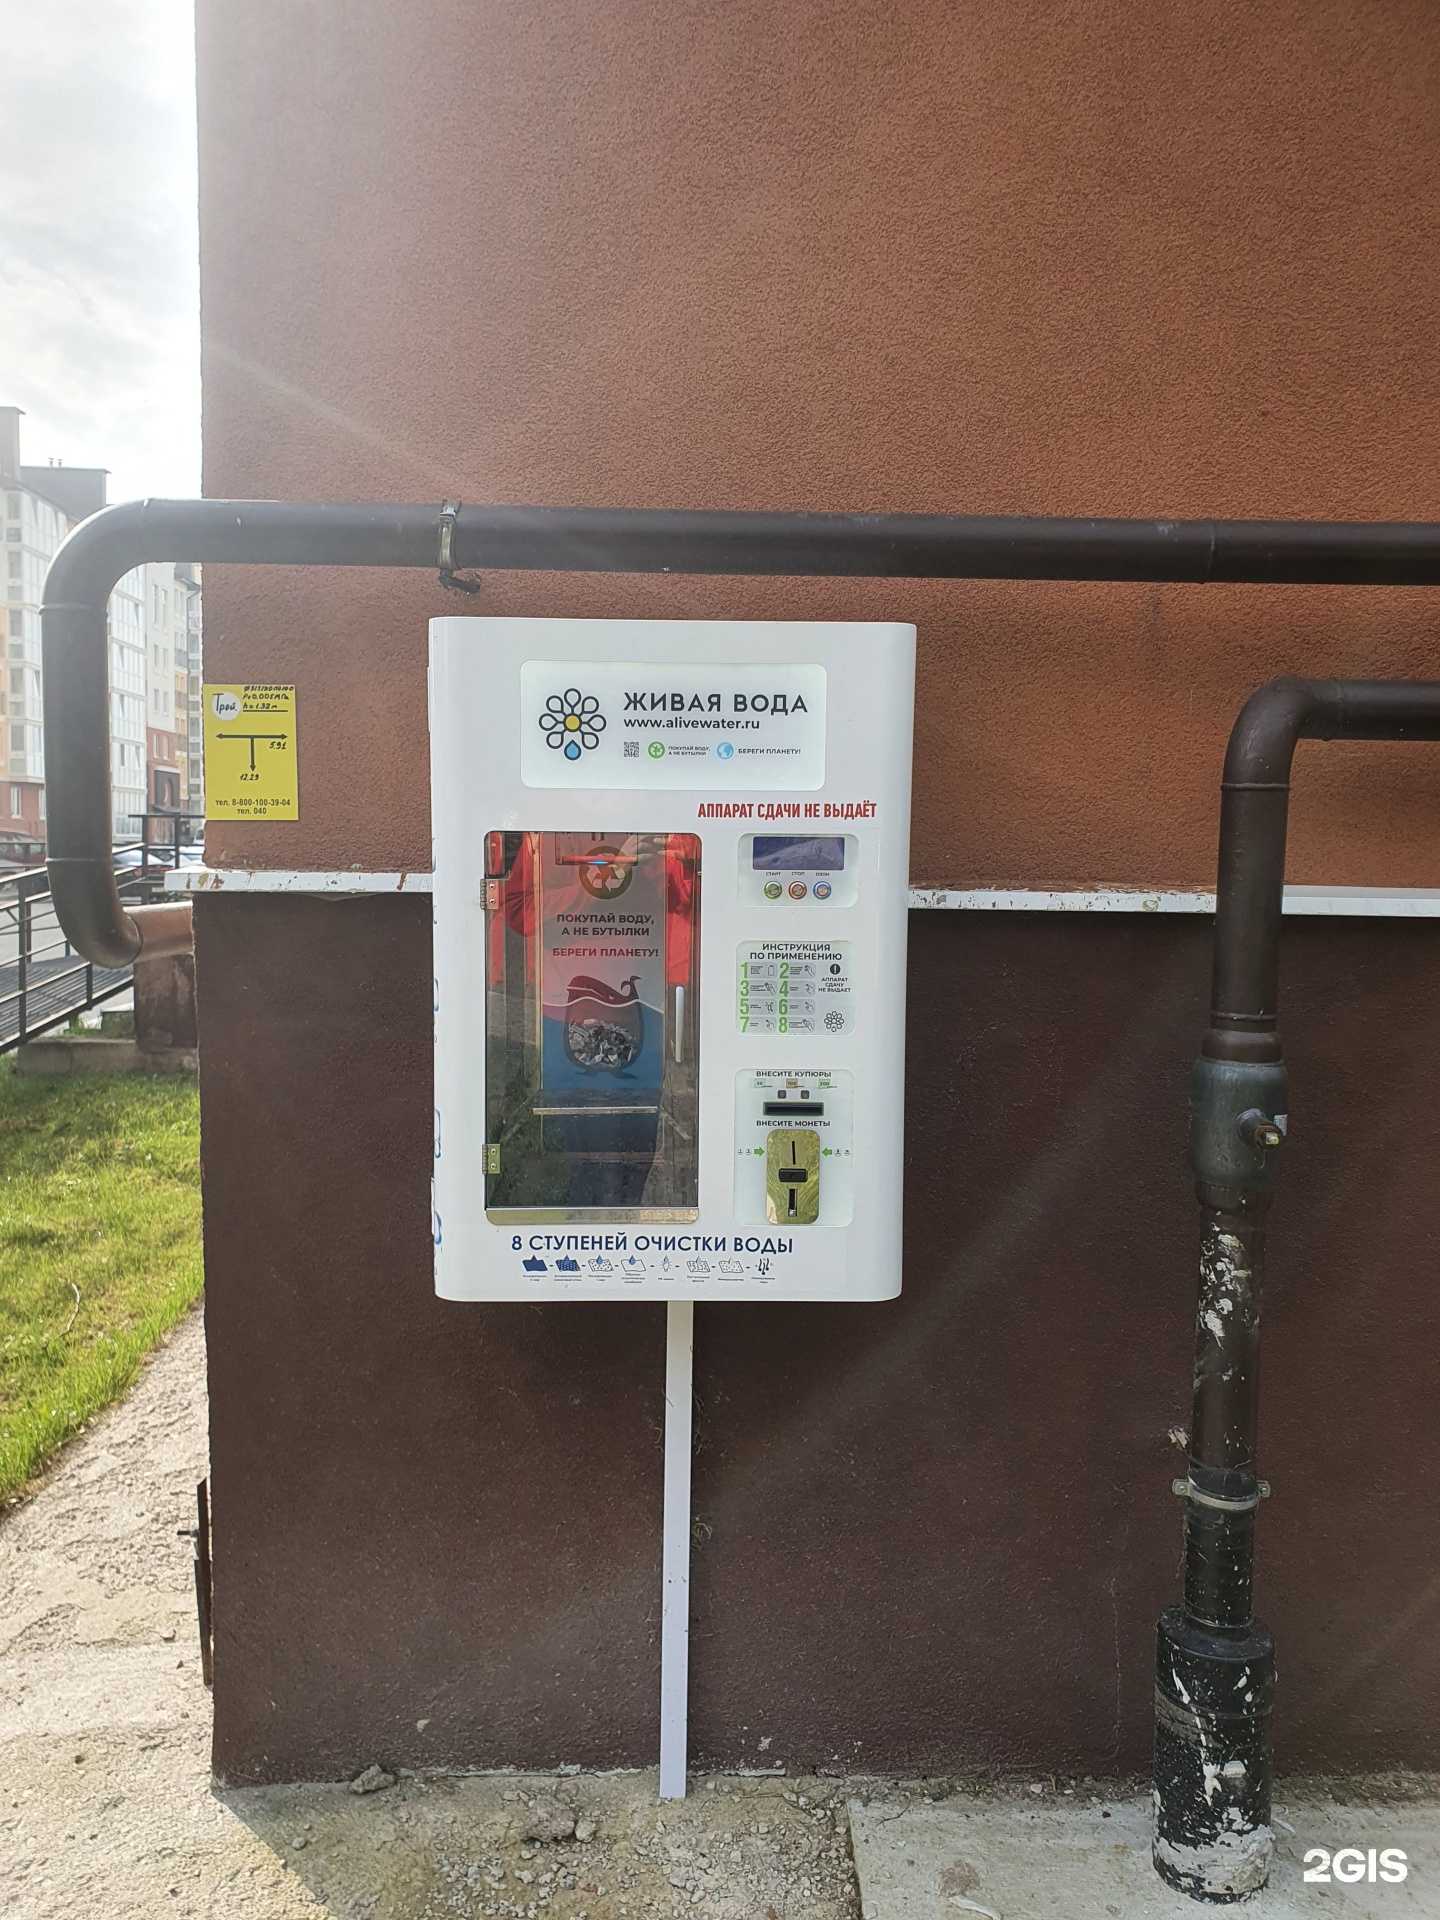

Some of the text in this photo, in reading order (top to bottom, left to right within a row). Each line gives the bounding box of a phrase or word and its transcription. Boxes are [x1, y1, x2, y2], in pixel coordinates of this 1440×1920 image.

[624, 692, 808, 716] ЖИВАЯ ВОДА
[624, 716, 760, 730] www.alivewater.ru
[698, 800, 877, 820] АППАРАТ СДАЧИ НЕ ВЫДАЁТ
[556, 913, 655, 925] ПОКУПАЙ ВОДУ,
[561, 927, 650, 936] А НЕ БУТЫЛКИ
[552, 948, 659, 957] БЕРЕГИ ПЛАНЕТУ!
[762, 943, 831, 952] ИНСТРУКЦИЯ
[750, 952, 842, 960] ПО ПРИМЕНЕНИЮ
[740, 962, 748, 978] 1
[780, 962, 789, 979] 2
[740, 980, 749, 996] 3
[779, 981, 789, 997] 4
[740, 998, 749, 1015] 5
[779, 998, 788, 1015] 6
[740, 1016, 749, 1033] 7
[779, 1017, 788, 1033] 8
[511, 1232, 793, 1254] 8 СТУПЕНЕЙ ОЧИСТКИ ВОДЫ
